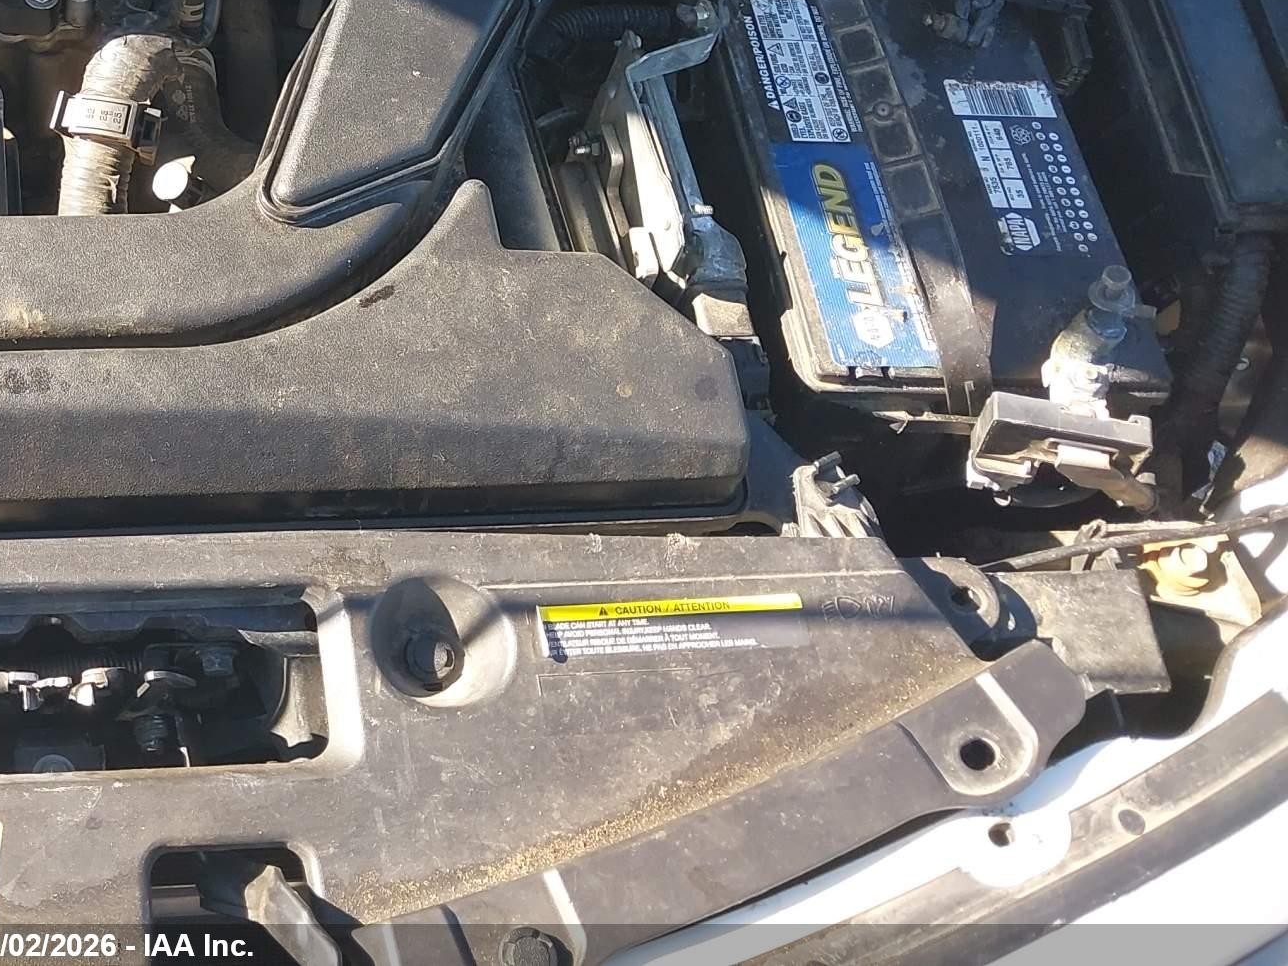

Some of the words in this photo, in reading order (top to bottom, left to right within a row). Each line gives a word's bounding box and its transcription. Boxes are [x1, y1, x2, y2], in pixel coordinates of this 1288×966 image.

[744, 16, 777, 98] DANGER/POISON
[812, 163, 884, 307] LEGEND
[1004, 219, 1033, 243] NAPA
[615, 605, 663, 616] CAUTION
[673, 600, 731, 613] ATTENTION
